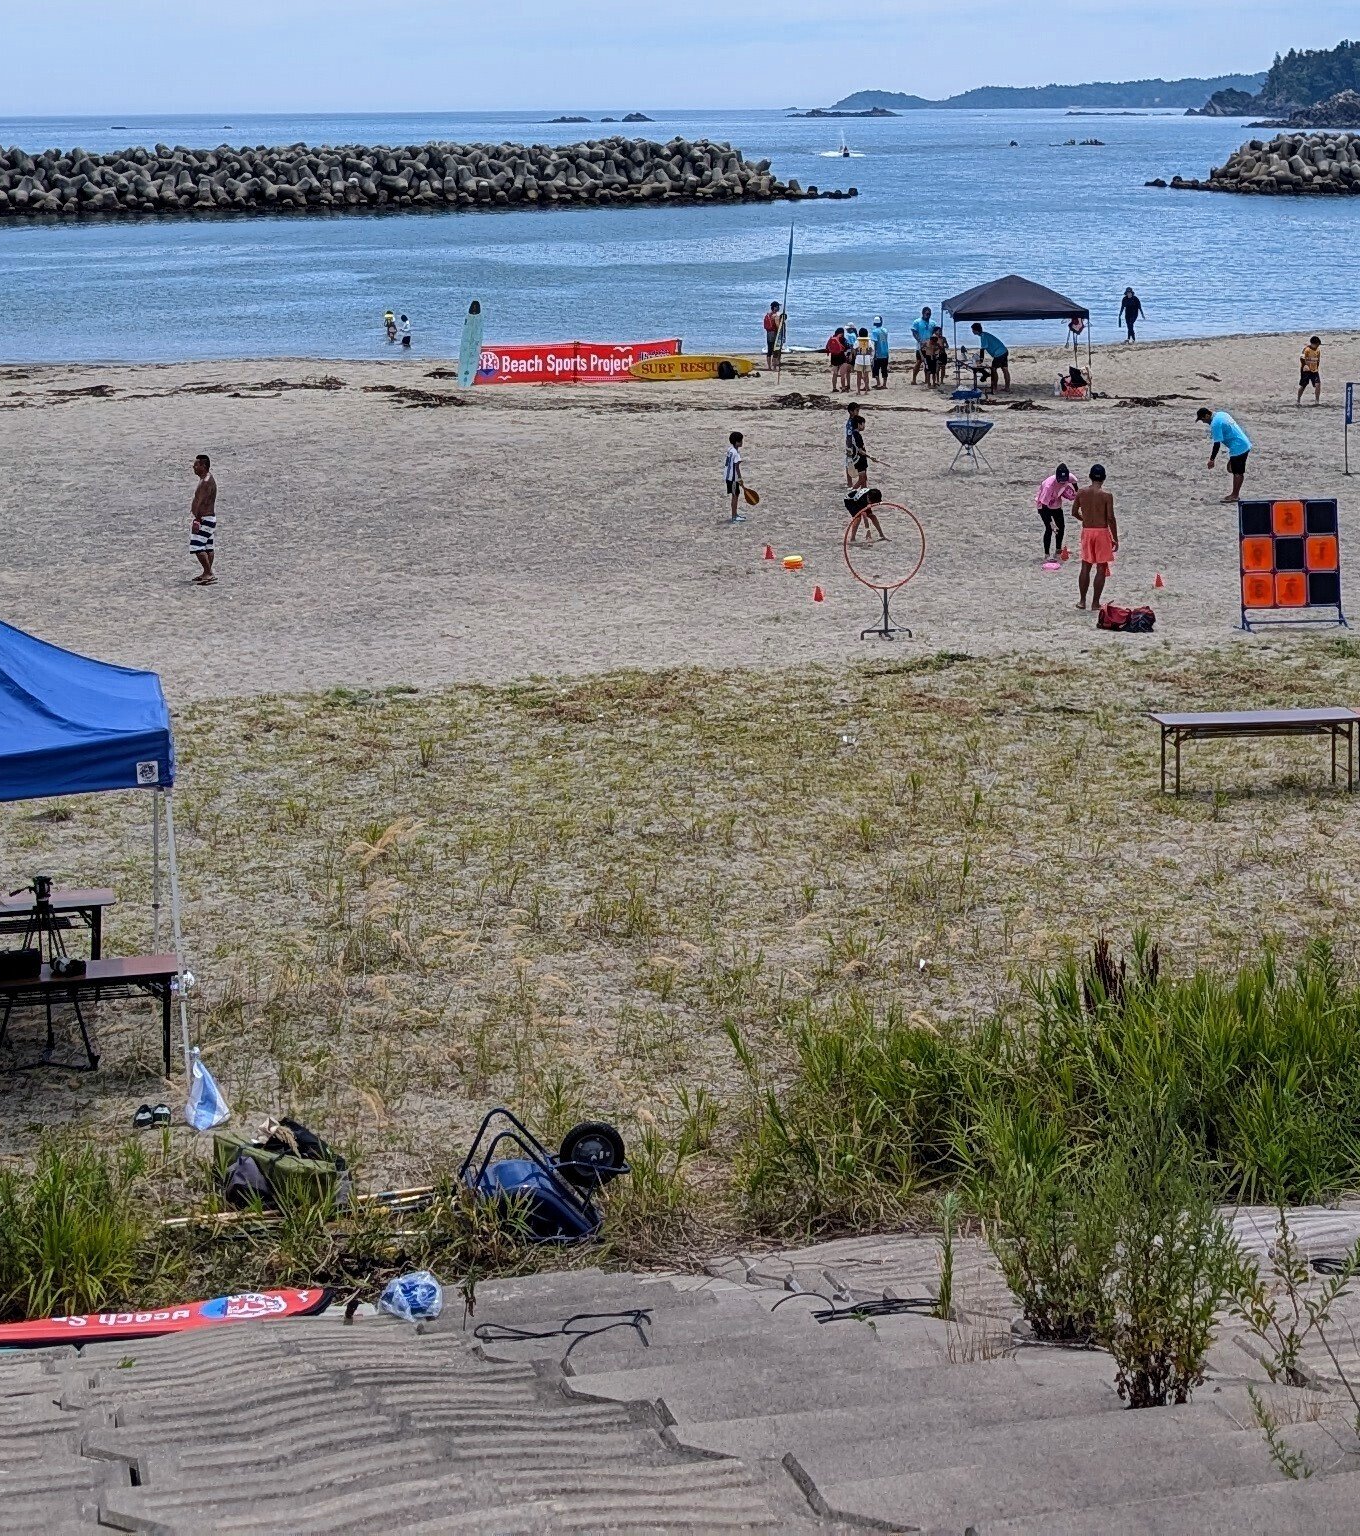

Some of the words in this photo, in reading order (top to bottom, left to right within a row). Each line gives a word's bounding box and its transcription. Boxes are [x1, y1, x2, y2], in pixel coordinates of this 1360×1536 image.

[501, 354, 543, 373] Beach
[546, 354, 587, 375] Sports
[590, 354, 633, 375] Project
[641, 363, 675, 375] SURF
[680, 362, 719, 373] RESCU
